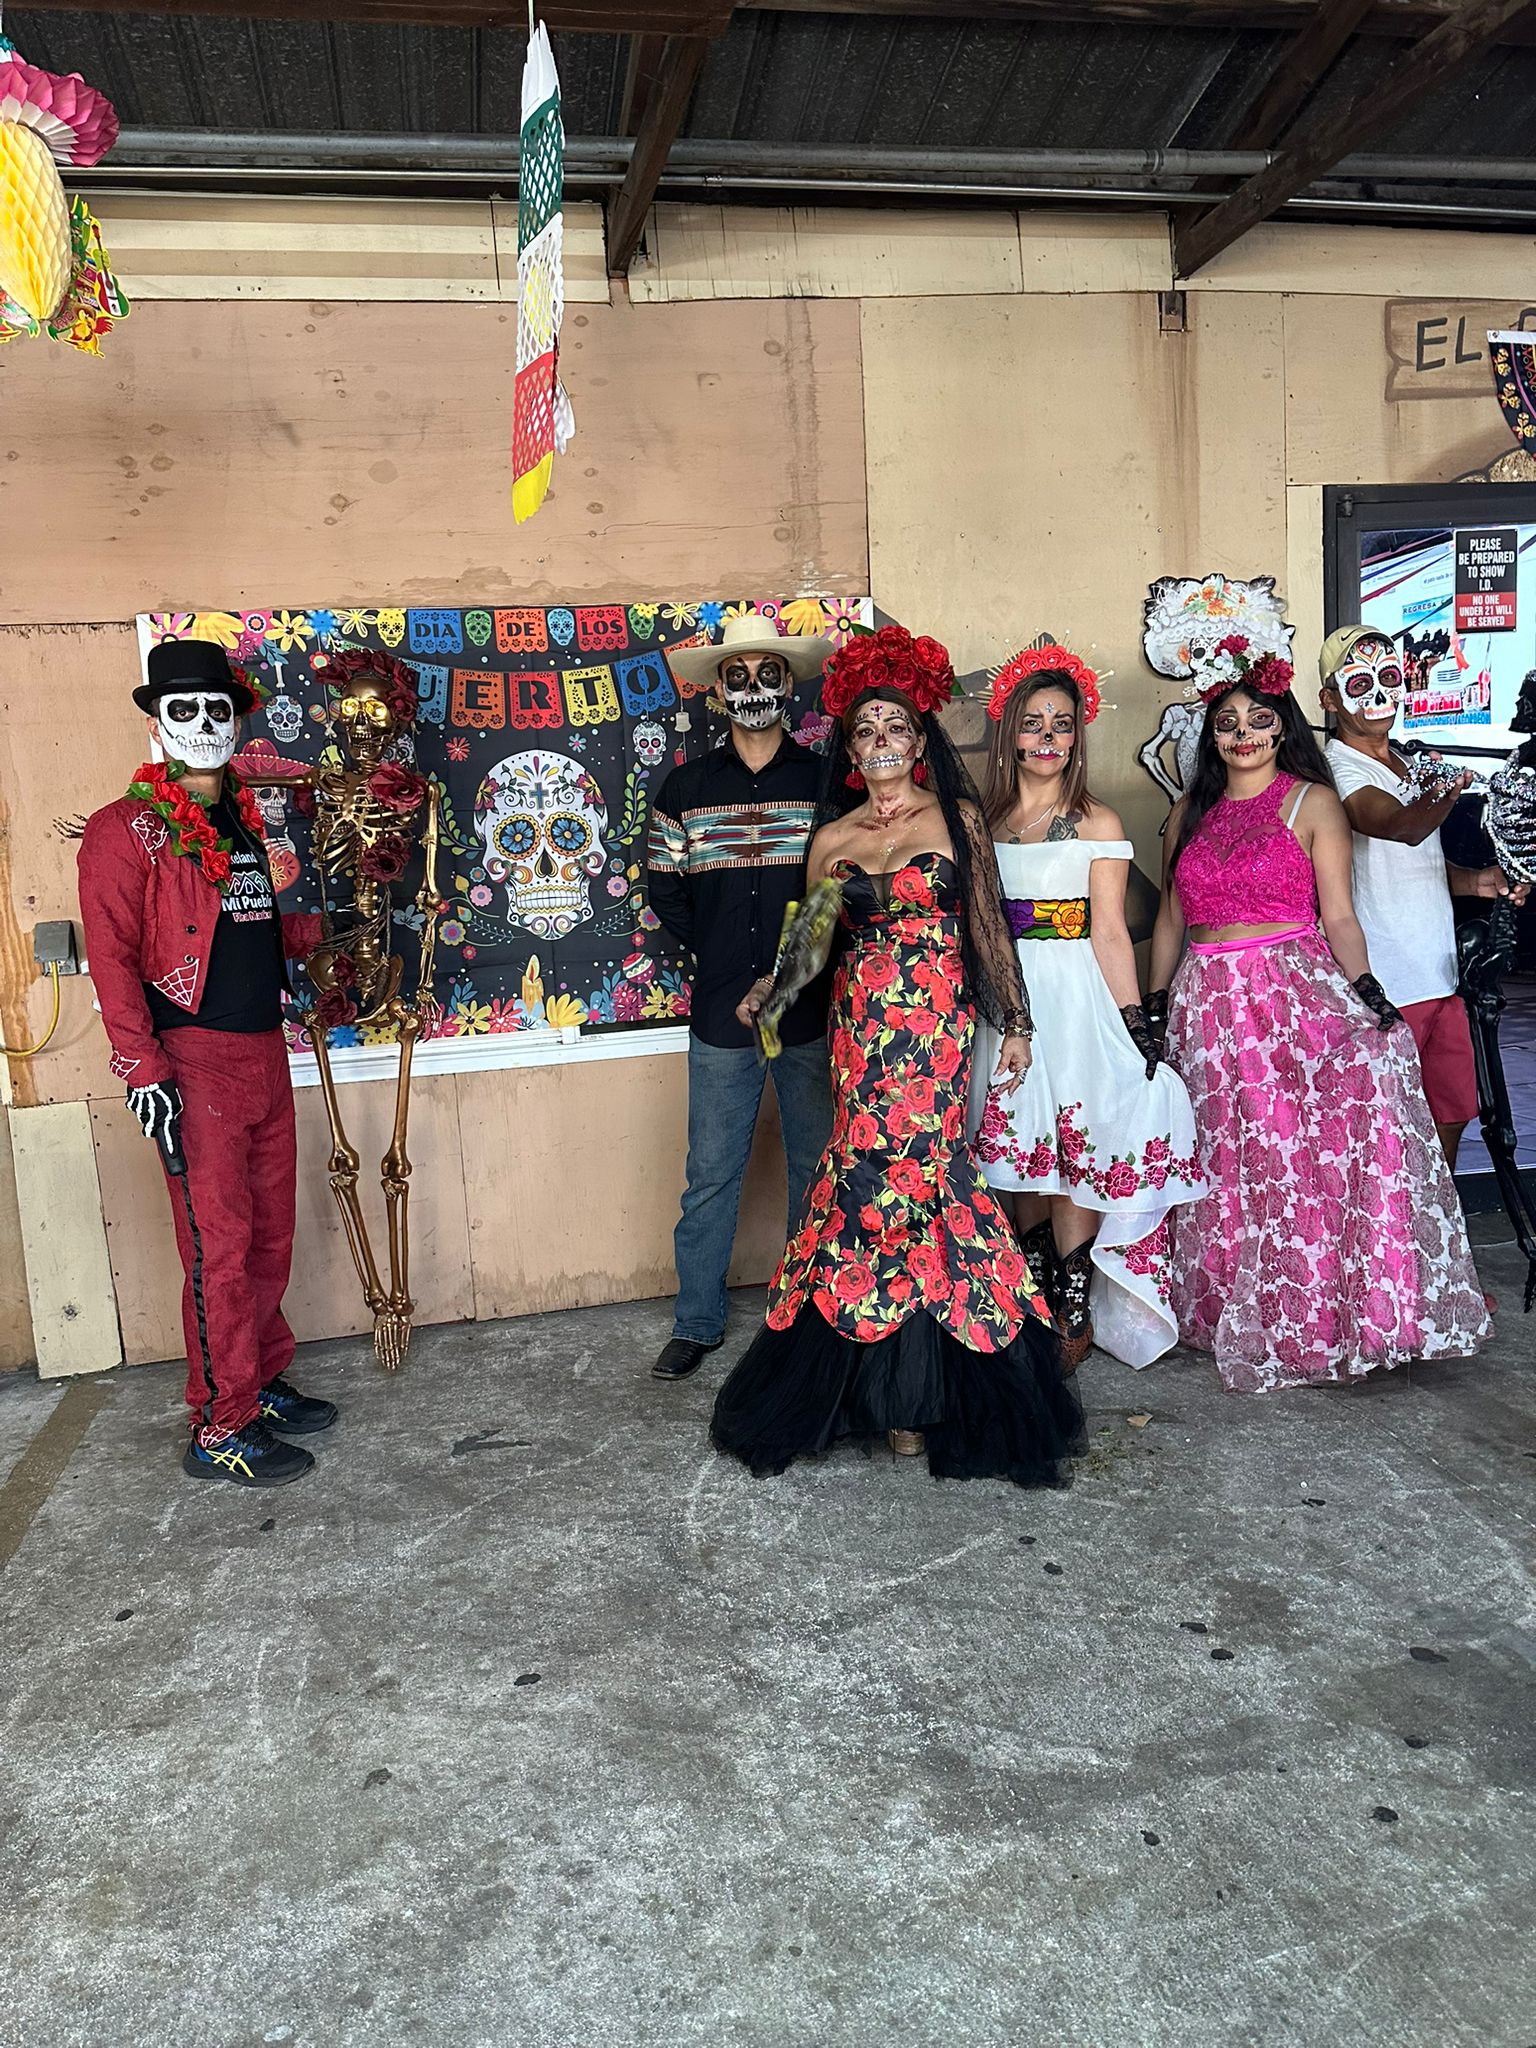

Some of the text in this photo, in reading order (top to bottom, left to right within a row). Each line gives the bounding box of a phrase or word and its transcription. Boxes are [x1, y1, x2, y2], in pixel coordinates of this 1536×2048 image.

[1416, 316, 1483, 372] EL
[1470, 538, 1501, 551] PLEASE
[1458, 551, 1515, 565] BE PREPARED
[1467, 565, 1505, 578] TO SHOW
[1479, 579, 1493, 591] I.D.
[1472, 594, 1500, 605] NO ONE
[1403, 602, 1437, 614] REGRESA
[1459, 604, 1513, 616] UNDER 21 WILL
[1467, 616, 1505, 627] BE SERVED
[415, 619, 623, 638] DIA DE LOS
[417, 664, 661, 710] UERTO
[222, 897, 242, 911] Mi
